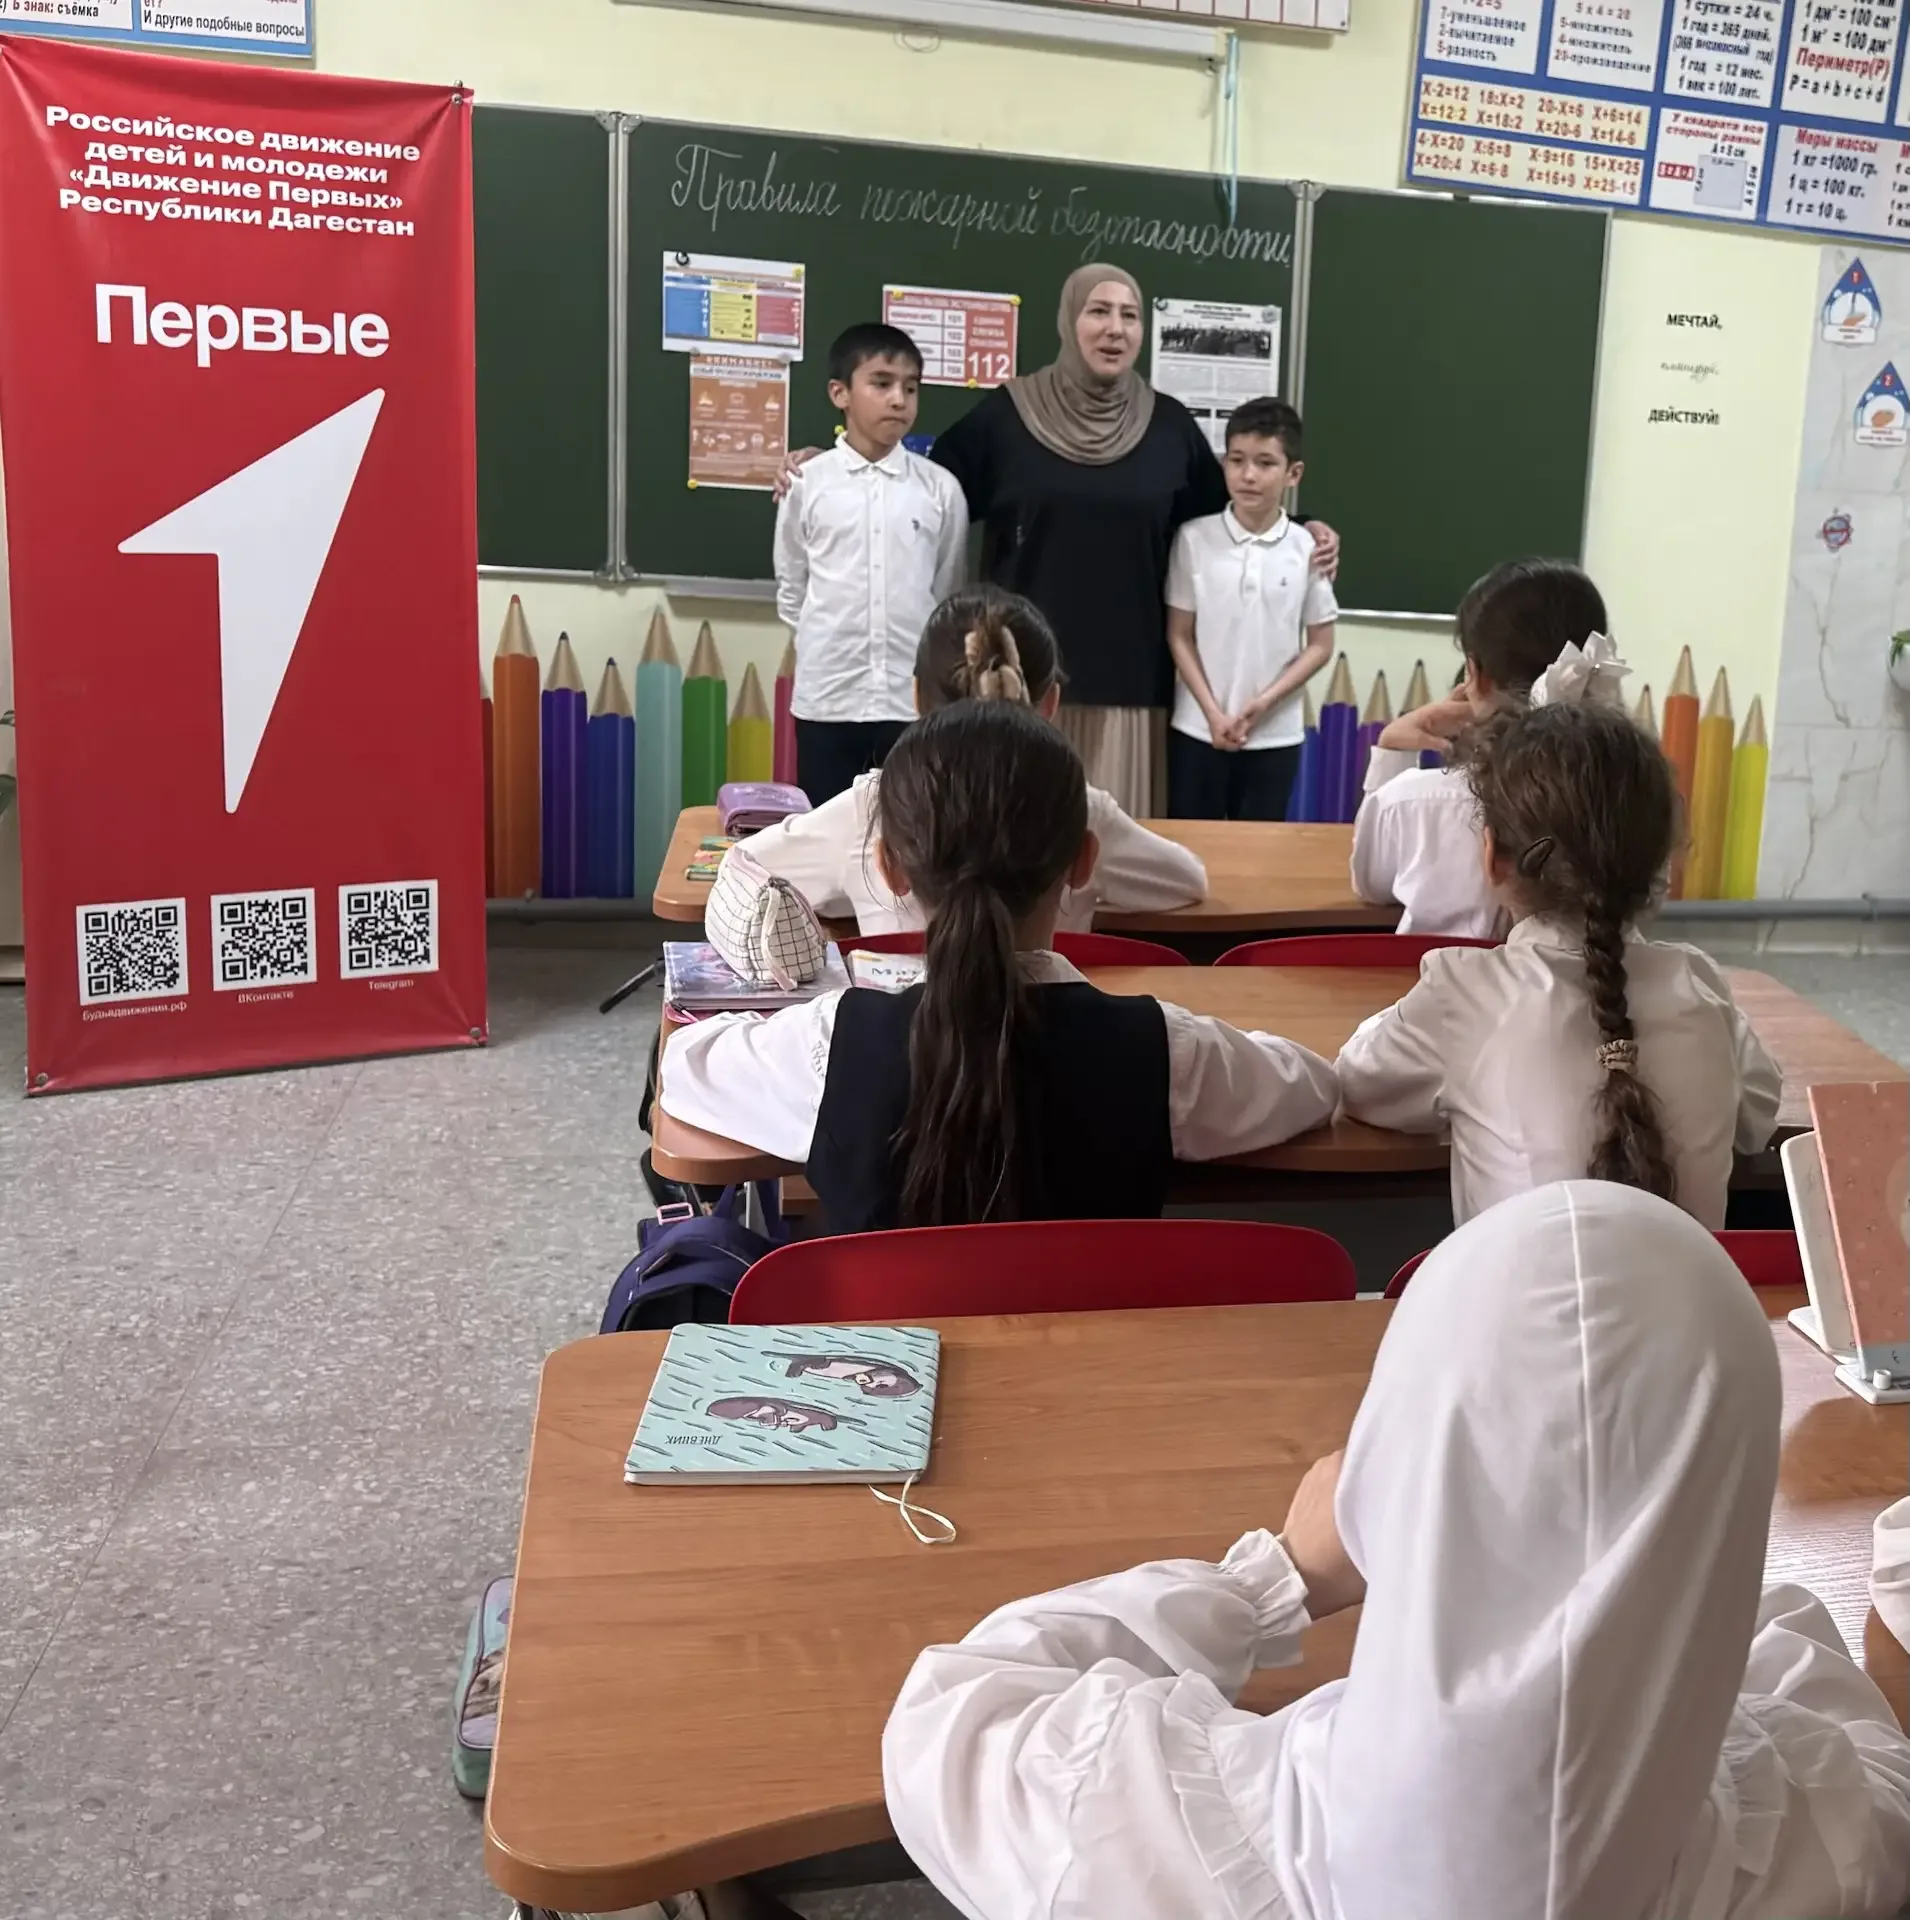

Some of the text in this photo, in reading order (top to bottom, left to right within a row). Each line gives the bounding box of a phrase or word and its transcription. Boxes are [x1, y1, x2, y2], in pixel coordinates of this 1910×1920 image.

[24, 1, 54, 13] знак:
[57, 3, 99, 16] съёмка
[1695, 1, 1730, 16] сутки
[1745, 5, 1760, 19] 24
[1806, 1, 1811, 17] 1
[1851, 8, 1872, 26] 100
[144, 10, 304, 37] И другие подобные вопросы
[1682, 16, 1688, 30] 1
[1690, 20, 1708, 35] год
[1721, 22, 1740, 37] 365
[1802, 24, 1808, 42] 1
[1845, 30, 1867, 50] 100
[1681, 55, 1687, 69] 1
[1688, 60, 1706, 75] год
[1726, 63, 1739, 77] 12
[1796, 48, 1890, 81] Периметр(Р)
[1679, 75, 1684, 89] 1
[1687, 80, 1705, 93] век
[1719, 81, 1737, 96] 100
[46, 105, 421, 162] Российское движение
[85, 140, 388, 184] детей и молодежи
[1793, 149, 1799, 165] 1
[69, 165, 403, 211] «Движение Первых»
[1790, 173, 1796, 189] 1
[1824, 178, 1846, 194] 100
[671, 144, 842, 232] Правила
[860, 184, 1042, 250] пожарной
[1786, 198, 1792, 213] 1
[1819, 202, 1833, 218] 10
[59, 189, 415, 237] Республики Дагестан
[96, 283, 390, 368] Первые
[1666, 313, 1723, 331] МЕЧТАЙ,
[968, 352, 1010, 380] 112
[1648, 405, 1720, 425] ДЕЙСТВУЙ!
[238, 990, 294, 1004] ВКонтакте
[369, 980, 414, 993] Telegram
[82, 1000, 188, 1022] Будьвдвижении.рф
[665, 1434, 723, 1445] ДНЕВНИК
